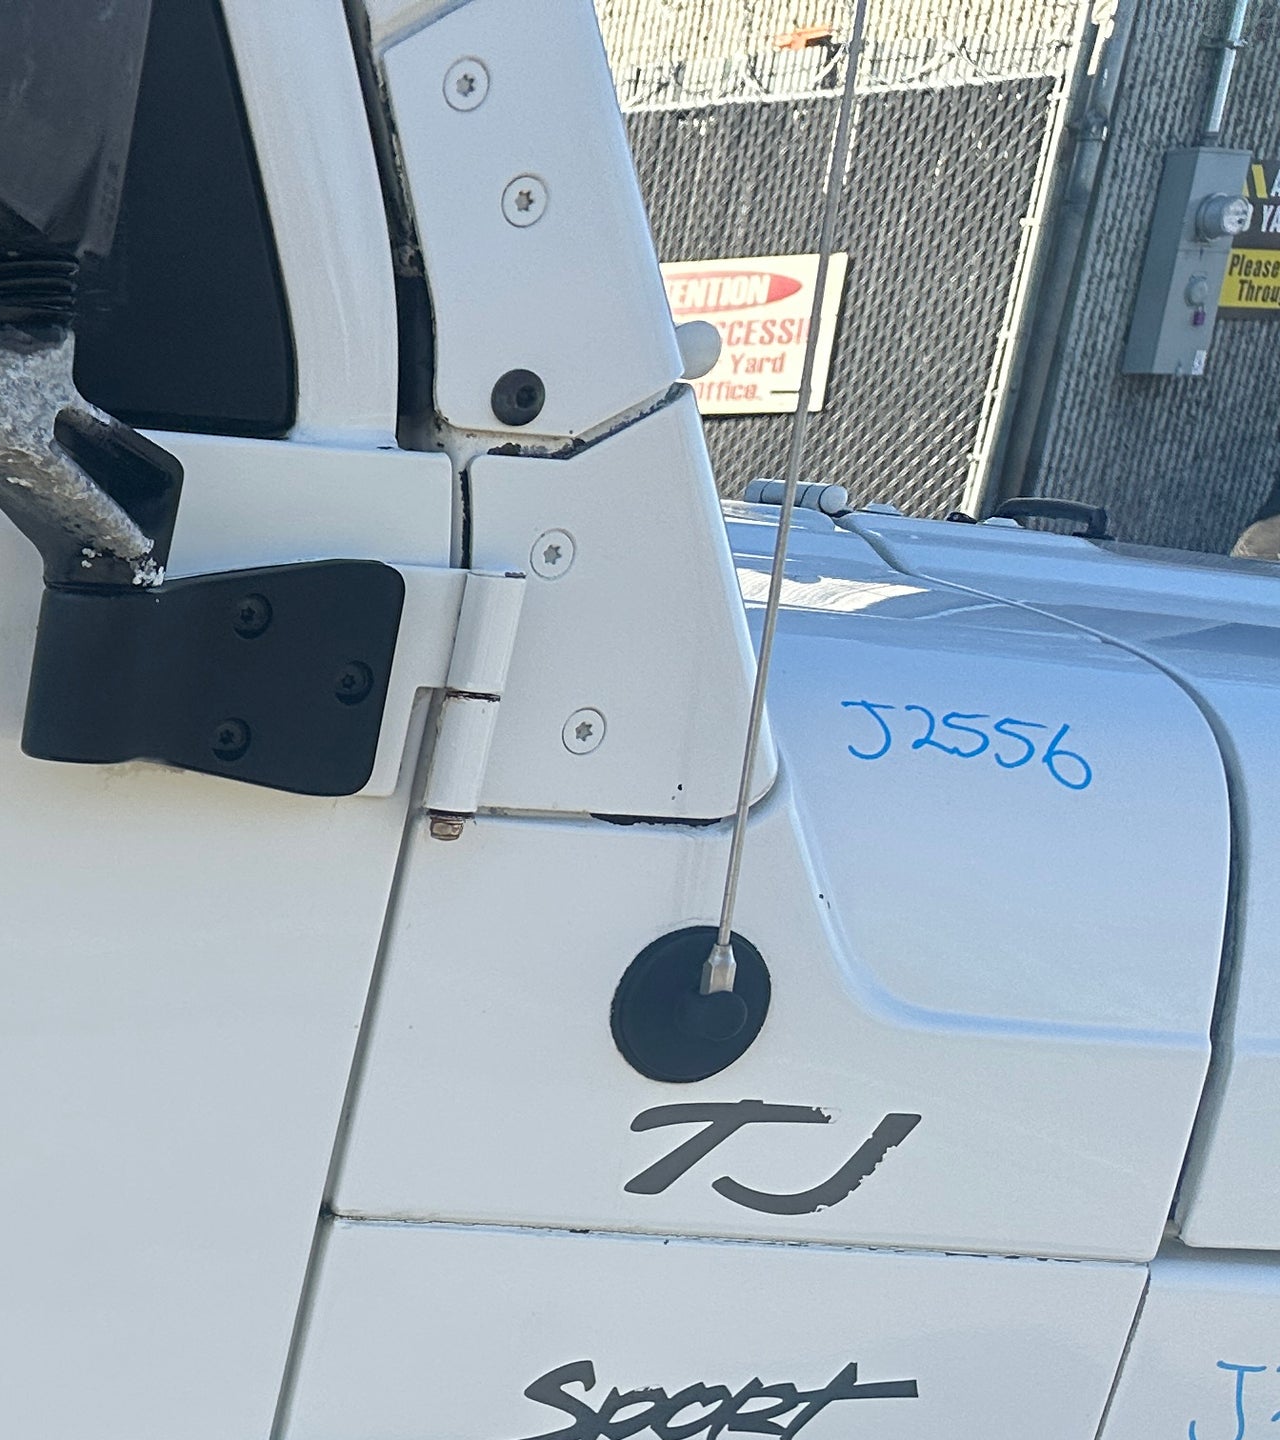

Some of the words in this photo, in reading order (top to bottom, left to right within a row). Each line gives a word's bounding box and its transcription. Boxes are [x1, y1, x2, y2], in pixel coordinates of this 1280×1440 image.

[1238, 279, 1280, 306] Throu
[730, 351, 787, 375] Yard
[840, 700, 1093, 790] J2556
[623, 1099, 923, 1215] TJ
